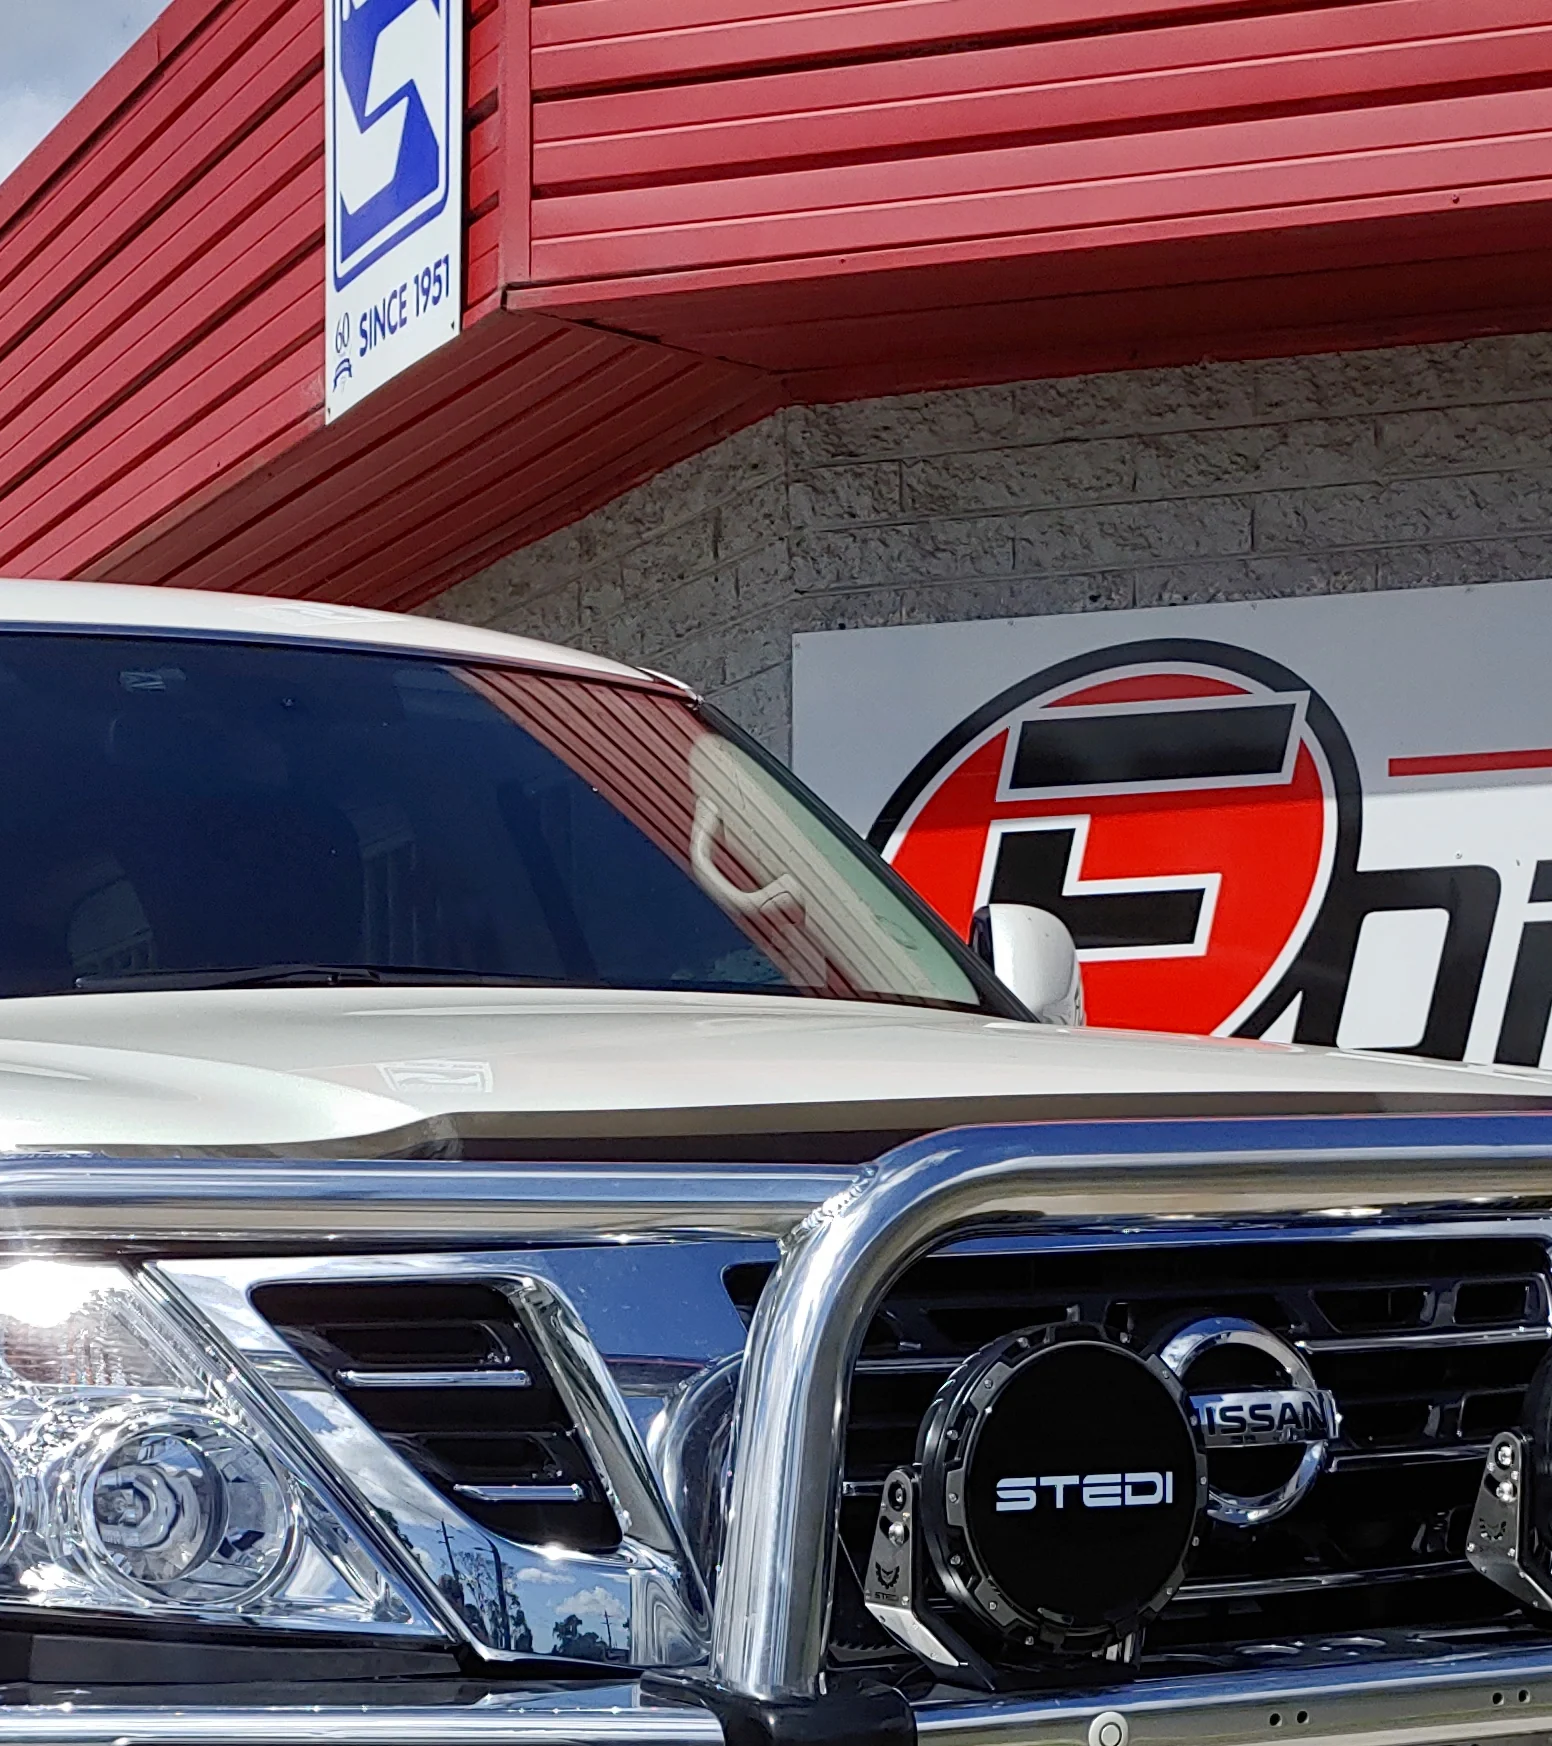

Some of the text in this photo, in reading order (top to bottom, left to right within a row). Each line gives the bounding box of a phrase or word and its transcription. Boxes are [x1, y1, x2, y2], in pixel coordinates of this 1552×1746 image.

[359, 254, 451, 358] SINCE 1951
[1198, 1401, 1330, 1436] ISSAN
[994, 1470, 1174, 1513] STEDI
